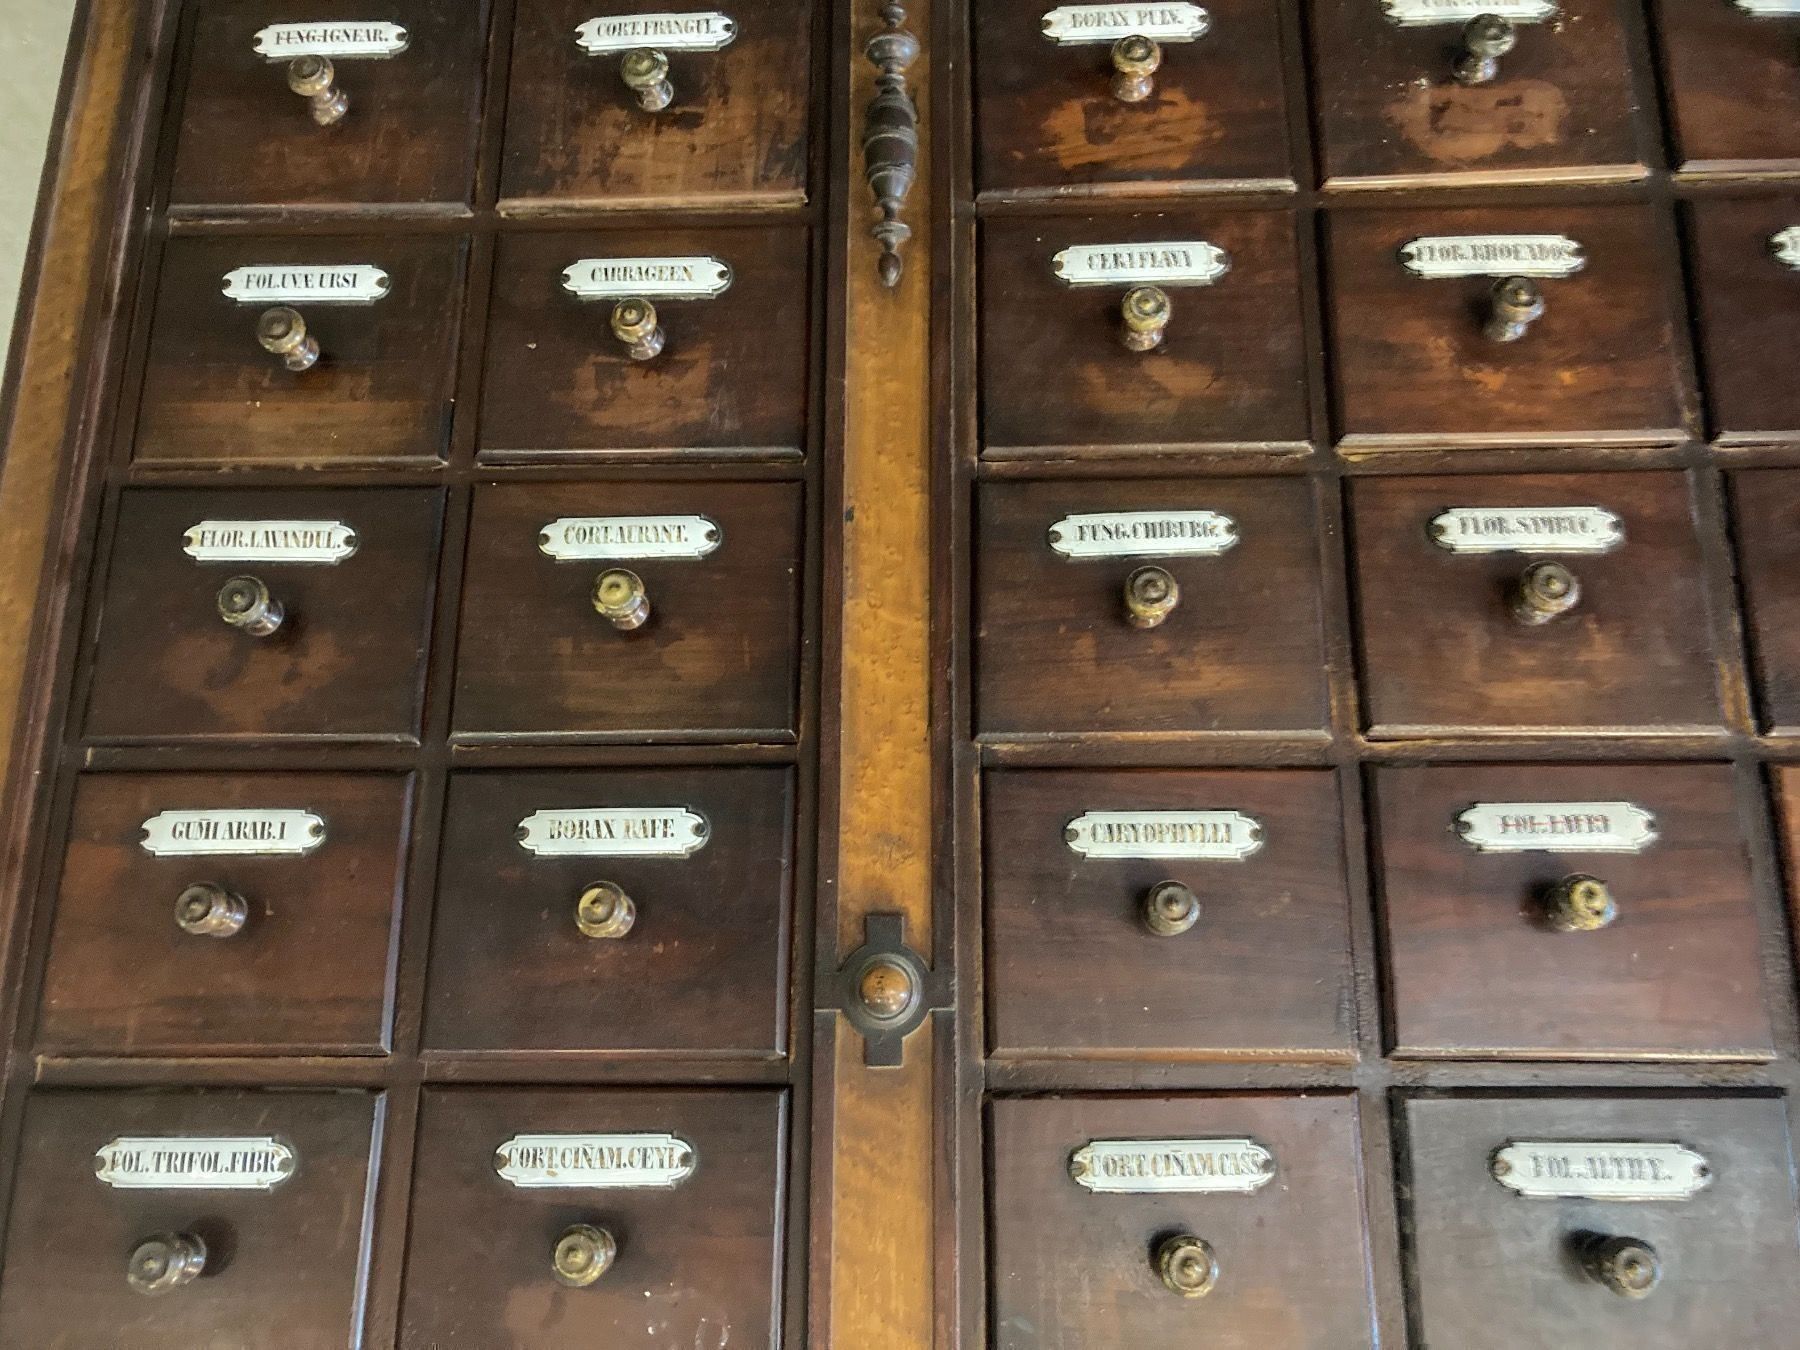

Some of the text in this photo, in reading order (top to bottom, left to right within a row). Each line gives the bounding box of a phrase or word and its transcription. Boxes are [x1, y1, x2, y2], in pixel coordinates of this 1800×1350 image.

[1071, 10, 1130, 28] BORAX
[319, 272, 358, 288] URSI
[590, 265, 694, 282] CARRAGEEN
[563, 525, 688, 545] CORT.AURANT.
[549, 819, 614, 840] BORAX
